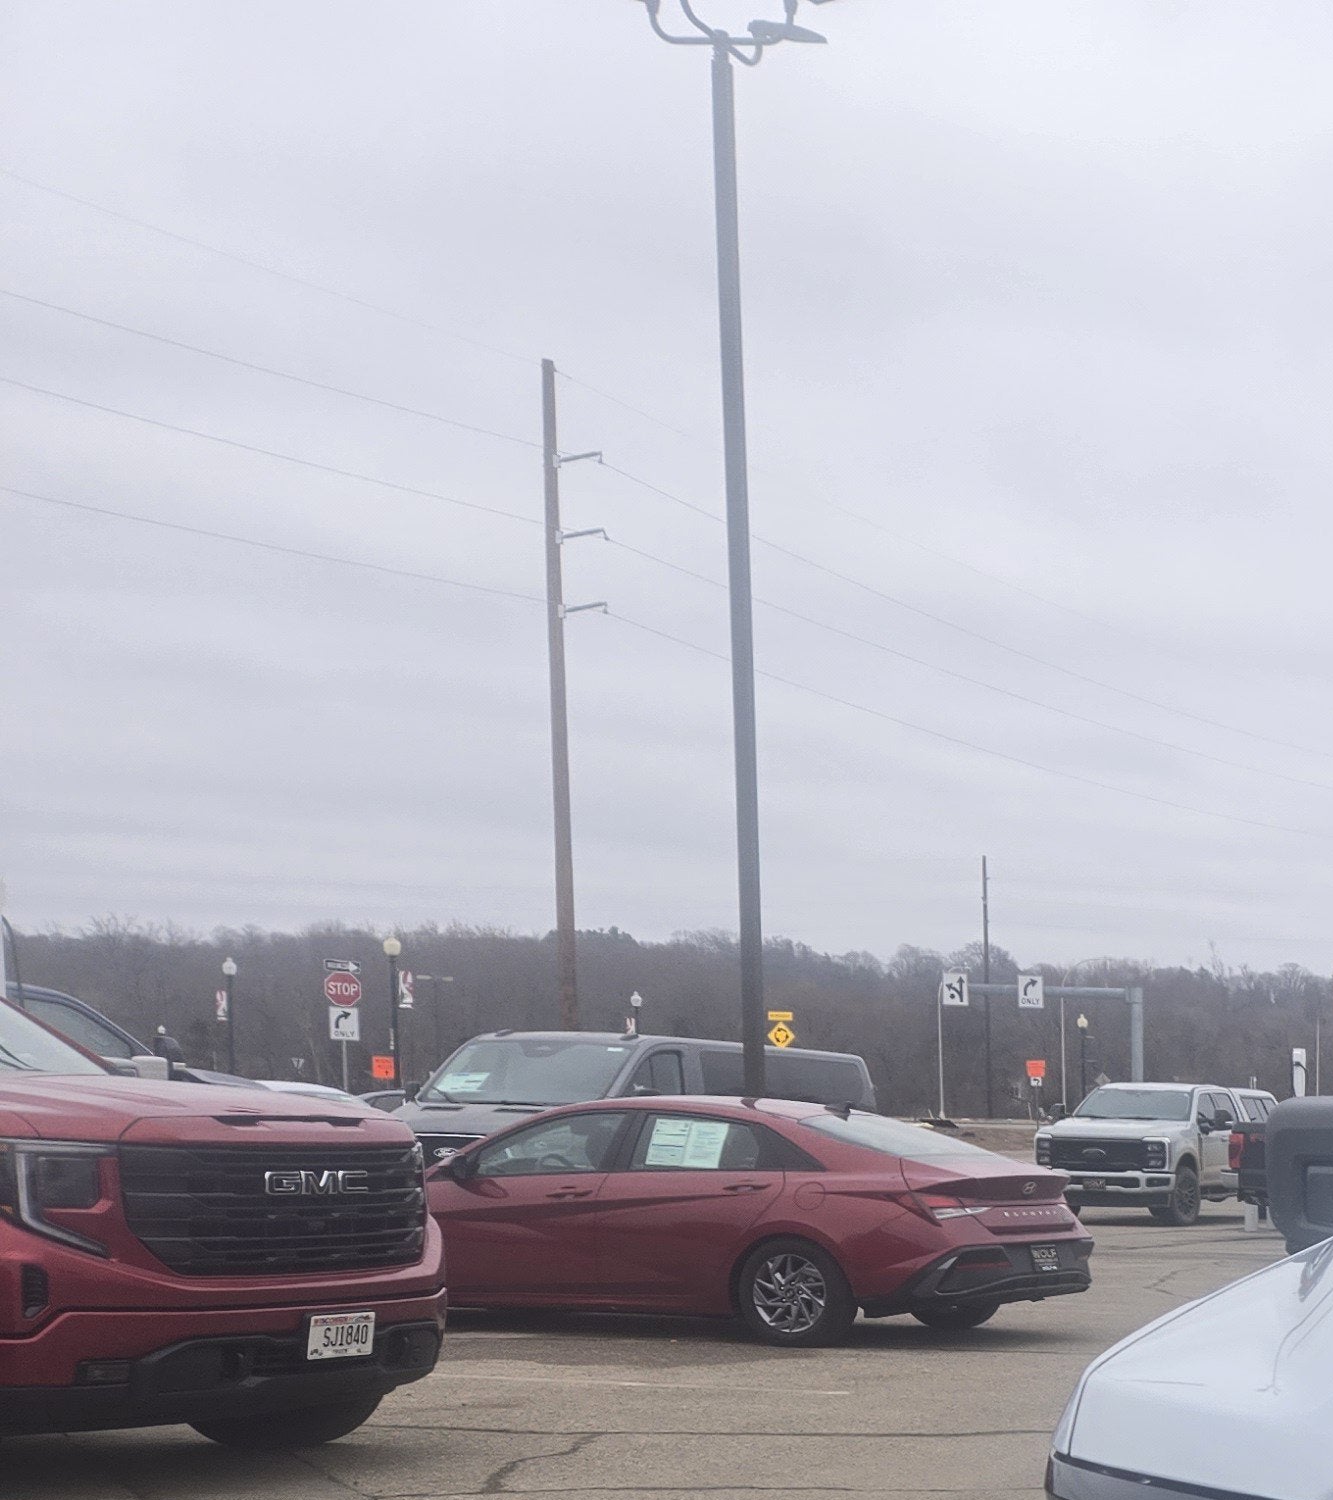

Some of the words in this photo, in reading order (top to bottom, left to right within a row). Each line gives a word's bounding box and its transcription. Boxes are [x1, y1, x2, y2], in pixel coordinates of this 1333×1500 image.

[328, 981, 358, 996] STOP
[333, 1029, 355, 1038] ONLY
[264, 1170, 369, 1195] GMC
[322, 1324, 369, 1347] SJ1840
